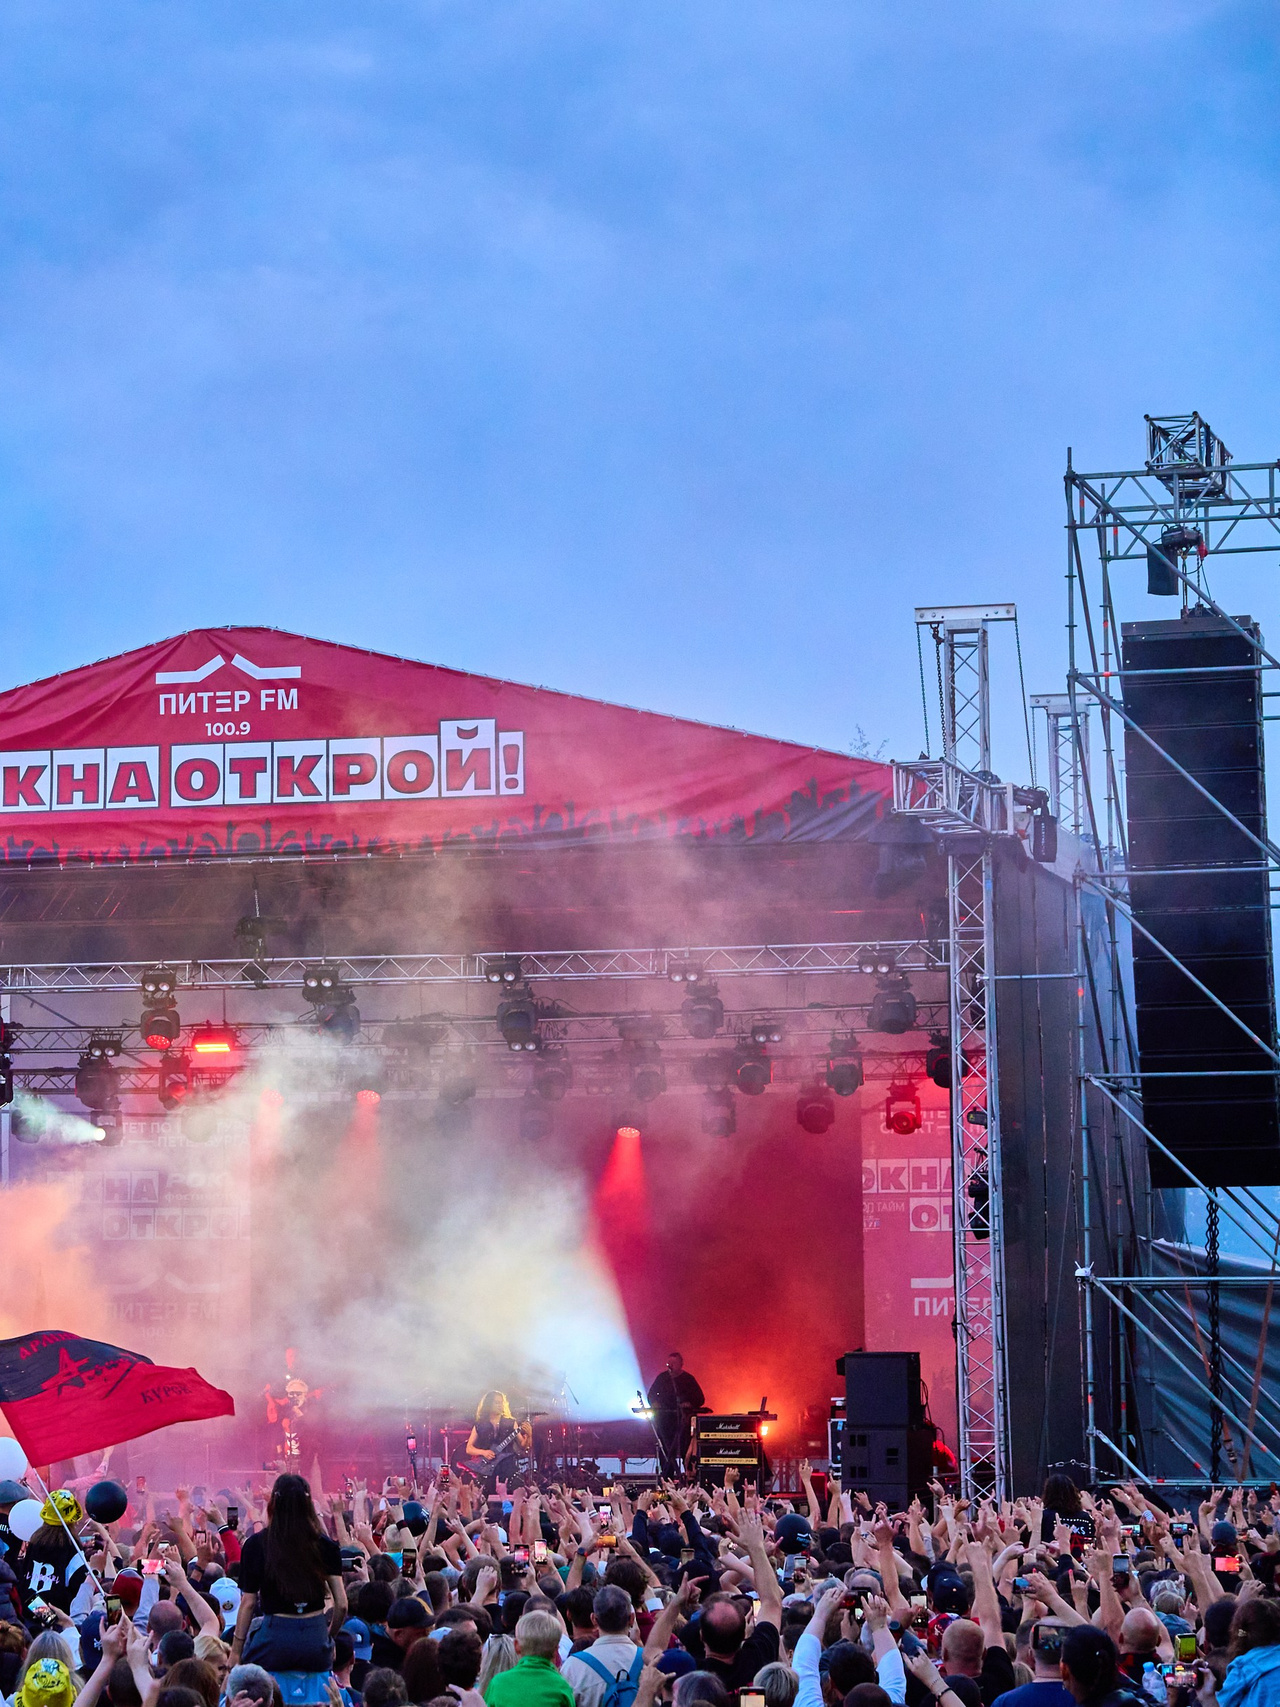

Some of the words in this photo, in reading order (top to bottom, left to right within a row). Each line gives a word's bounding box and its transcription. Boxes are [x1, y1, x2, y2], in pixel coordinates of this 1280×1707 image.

[159, 691, 251, 715] ПИТЕР
[260, 688, 298, 711] FM
[205, 721, 251, 737] 100.9
[173, 724, 521, 802] ОТКРОЙ!
[139, 1382, 193, 1406] КУРСК
